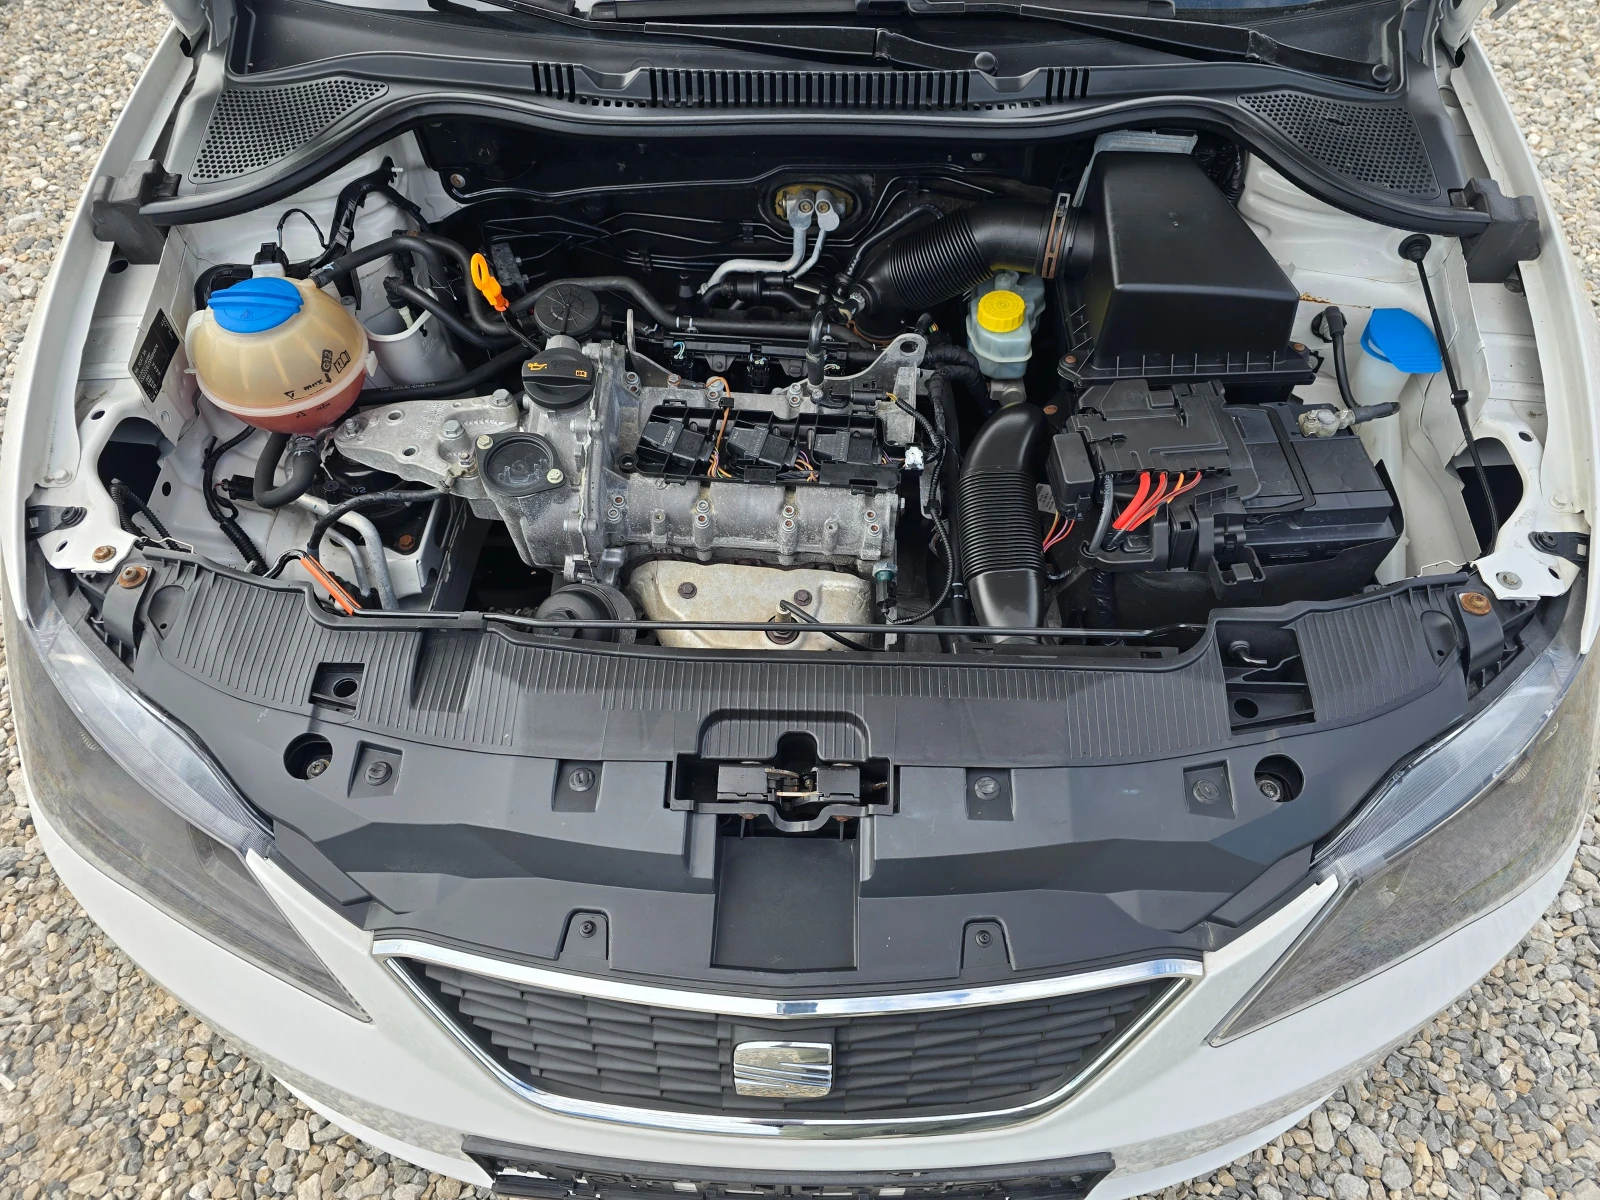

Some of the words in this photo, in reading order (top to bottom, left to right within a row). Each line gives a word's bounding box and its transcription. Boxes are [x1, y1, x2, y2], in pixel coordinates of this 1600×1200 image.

[322, 351, 332, 370] G12
[303, 379, 324, 391] max
[351, 486, 367, 494] 02
